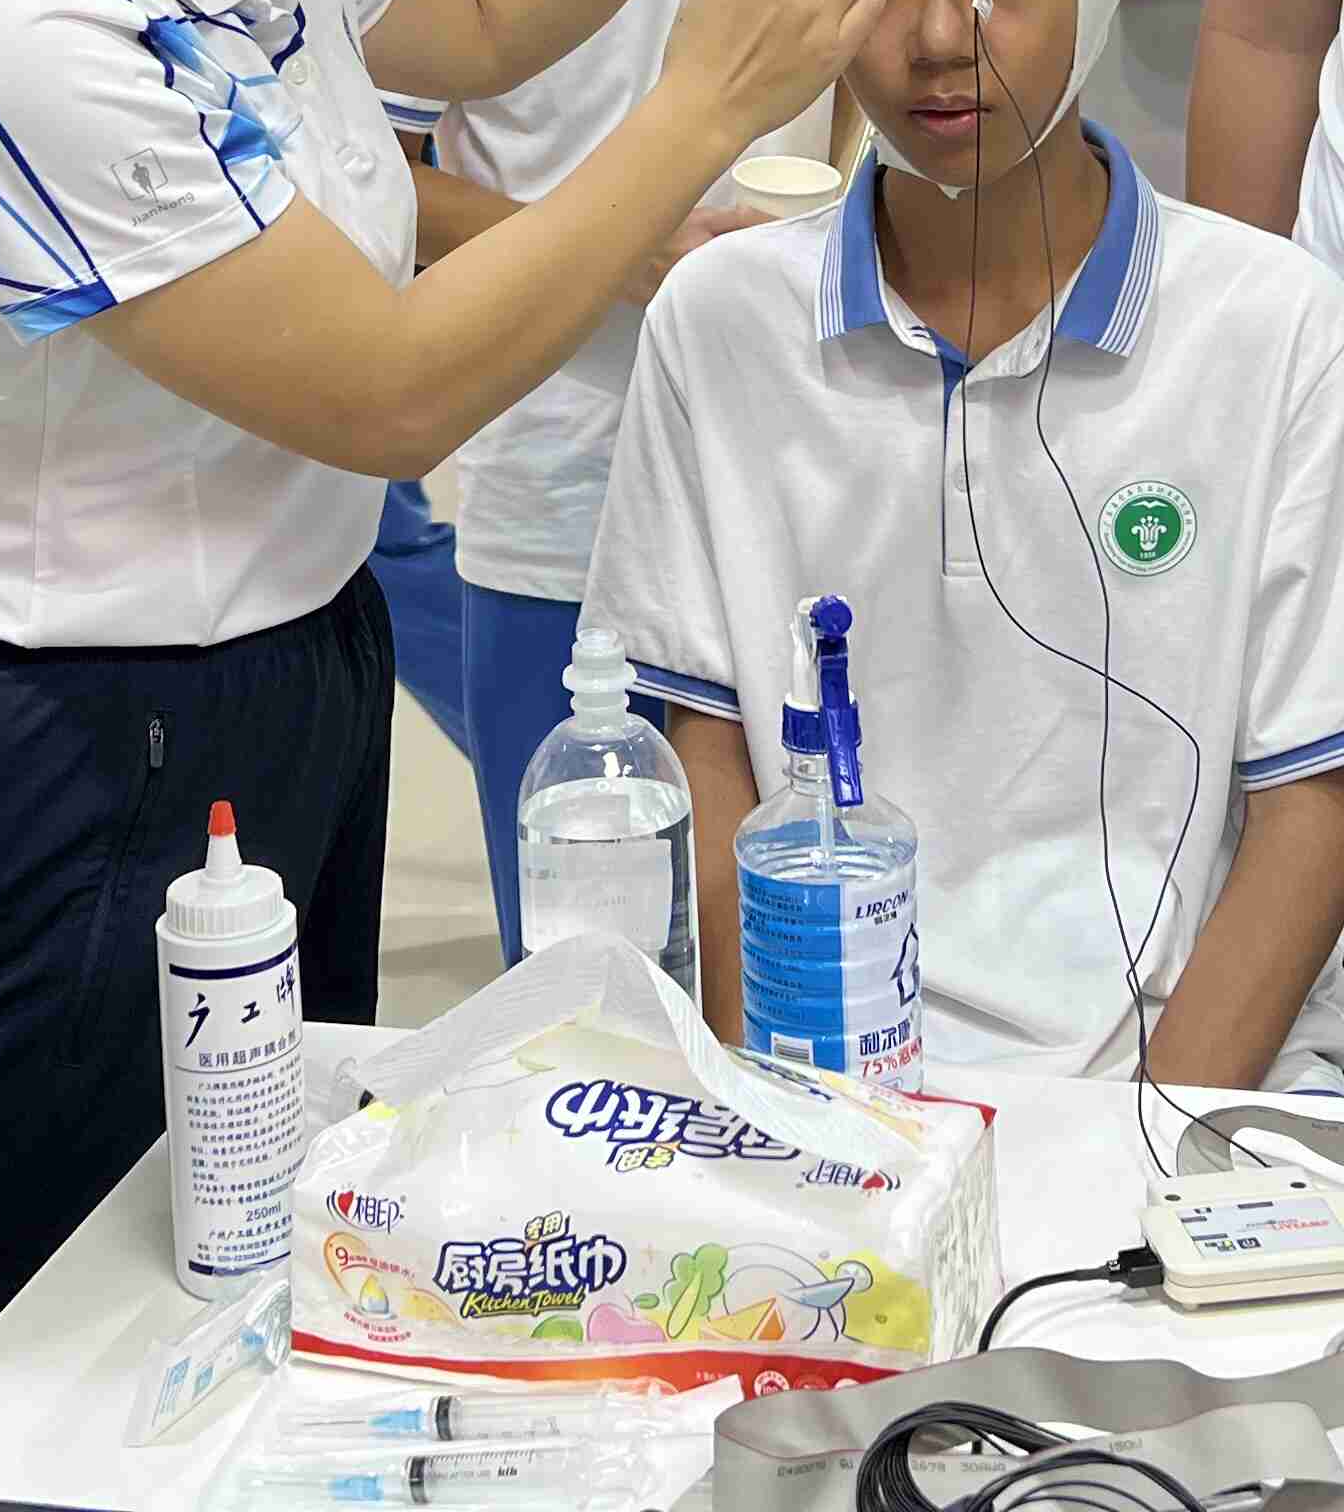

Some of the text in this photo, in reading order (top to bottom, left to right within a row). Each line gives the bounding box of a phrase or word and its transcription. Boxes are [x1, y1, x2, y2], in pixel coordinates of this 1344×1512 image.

[855, 889, 909, 920] LIRCON
[245, 1202, 282, 1223] 250ml
[435, 1235, 626, 1293] 厨房纸巾
[462, 1292, 585, 1318] Kitchen Towel
